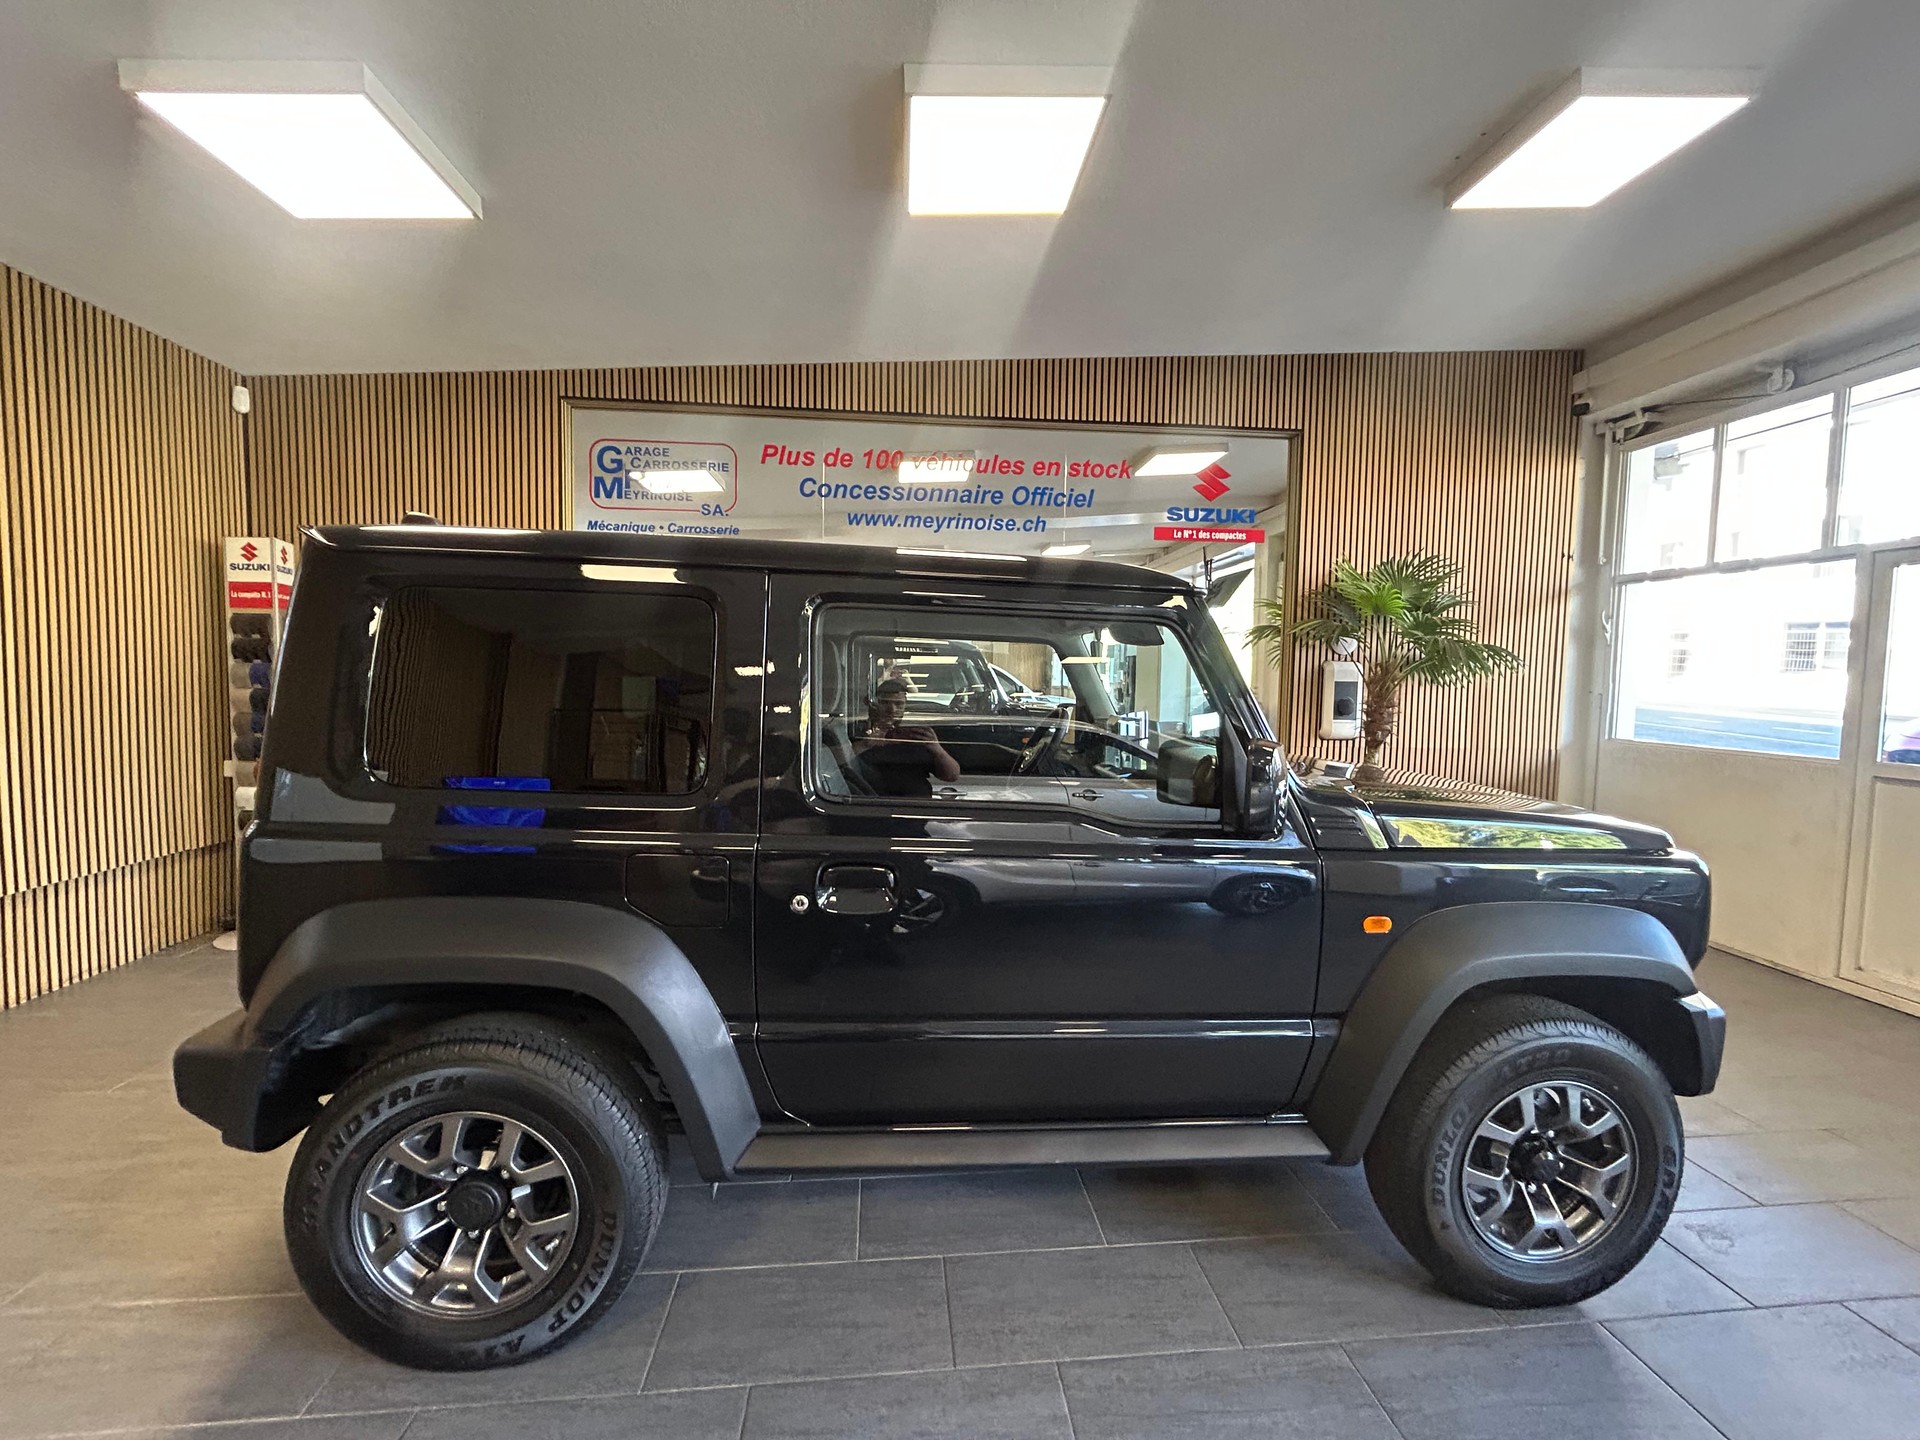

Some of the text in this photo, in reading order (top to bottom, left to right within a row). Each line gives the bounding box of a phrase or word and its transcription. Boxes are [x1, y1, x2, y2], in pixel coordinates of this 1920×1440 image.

[630, 457, 729, 473] CARROSSERIE
[760, 444, 1132, 479] Plus de 100 véhicules en stock
[799, 477, 1095, 509] Concessionnaire Officiel
[701, 504, 729, 517] SA.
[1167, 506, 1256, 524] SUZUKI
[587, 520, 740, 536] Mécanique Carrosserie
[847, 511, 1047, 533] www.meyrinoise.ch
[1173, 529, 1182, 539] Le
[1198, 531, 1210, 540] des
[1211, 532, 1247, 542] compactes
[229, 562, 270, 571] SUZUKI
[547, 1210, 618, 1334] DUNLOP
